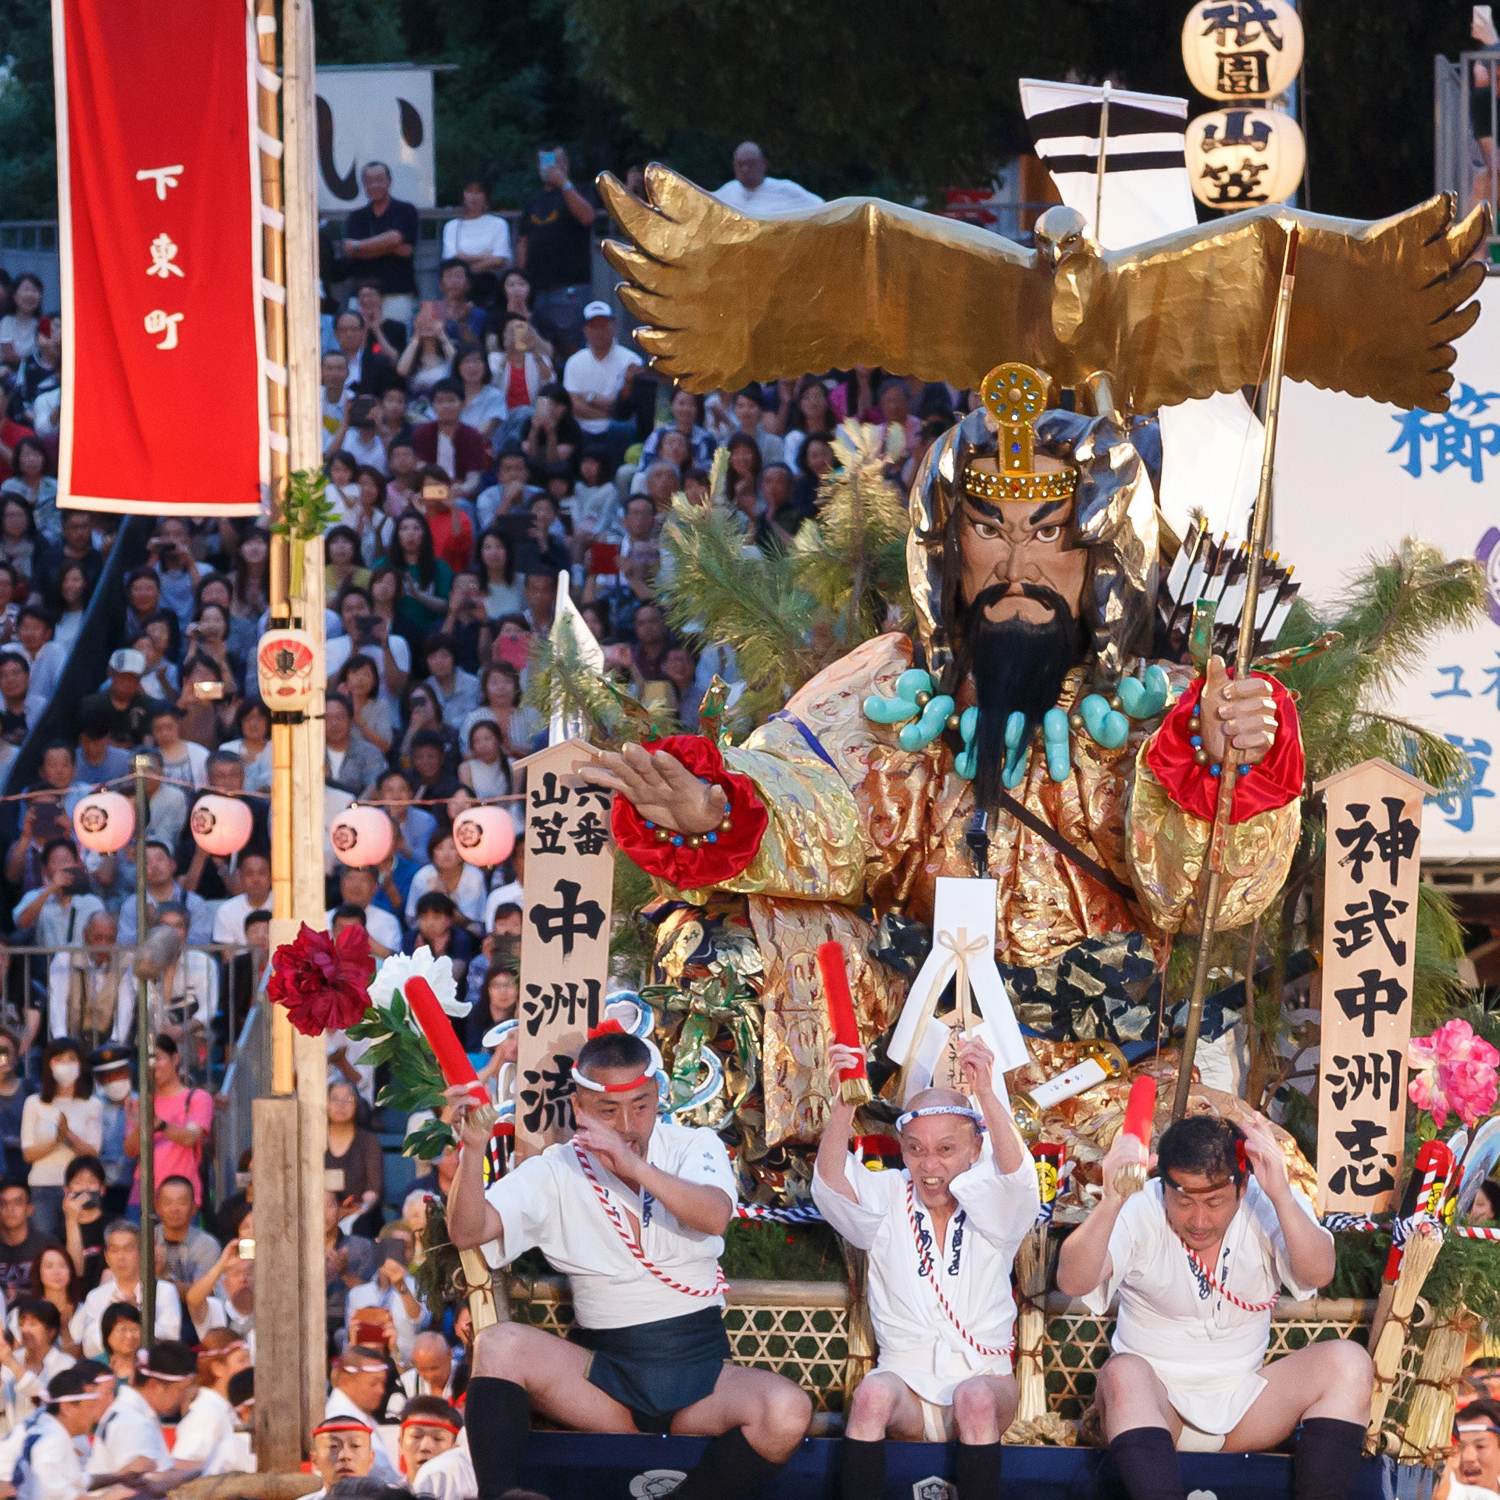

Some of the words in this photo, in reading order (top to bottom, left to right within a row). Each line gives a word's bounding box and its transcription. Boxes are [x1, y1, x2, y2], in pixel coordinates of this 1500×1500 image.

[1203, 2, 1283, 94] 祇園
[1200, 111, 1273, 205] 山笠
[136, 164, 185, 350] 下東町
[530, 772, 570, 856] 山笠
[567, 783, 611, 856] 六番
[519, 878, 606, 1133] 中洲流
[1325, 797, 1421, 1198] 神武中洲志
